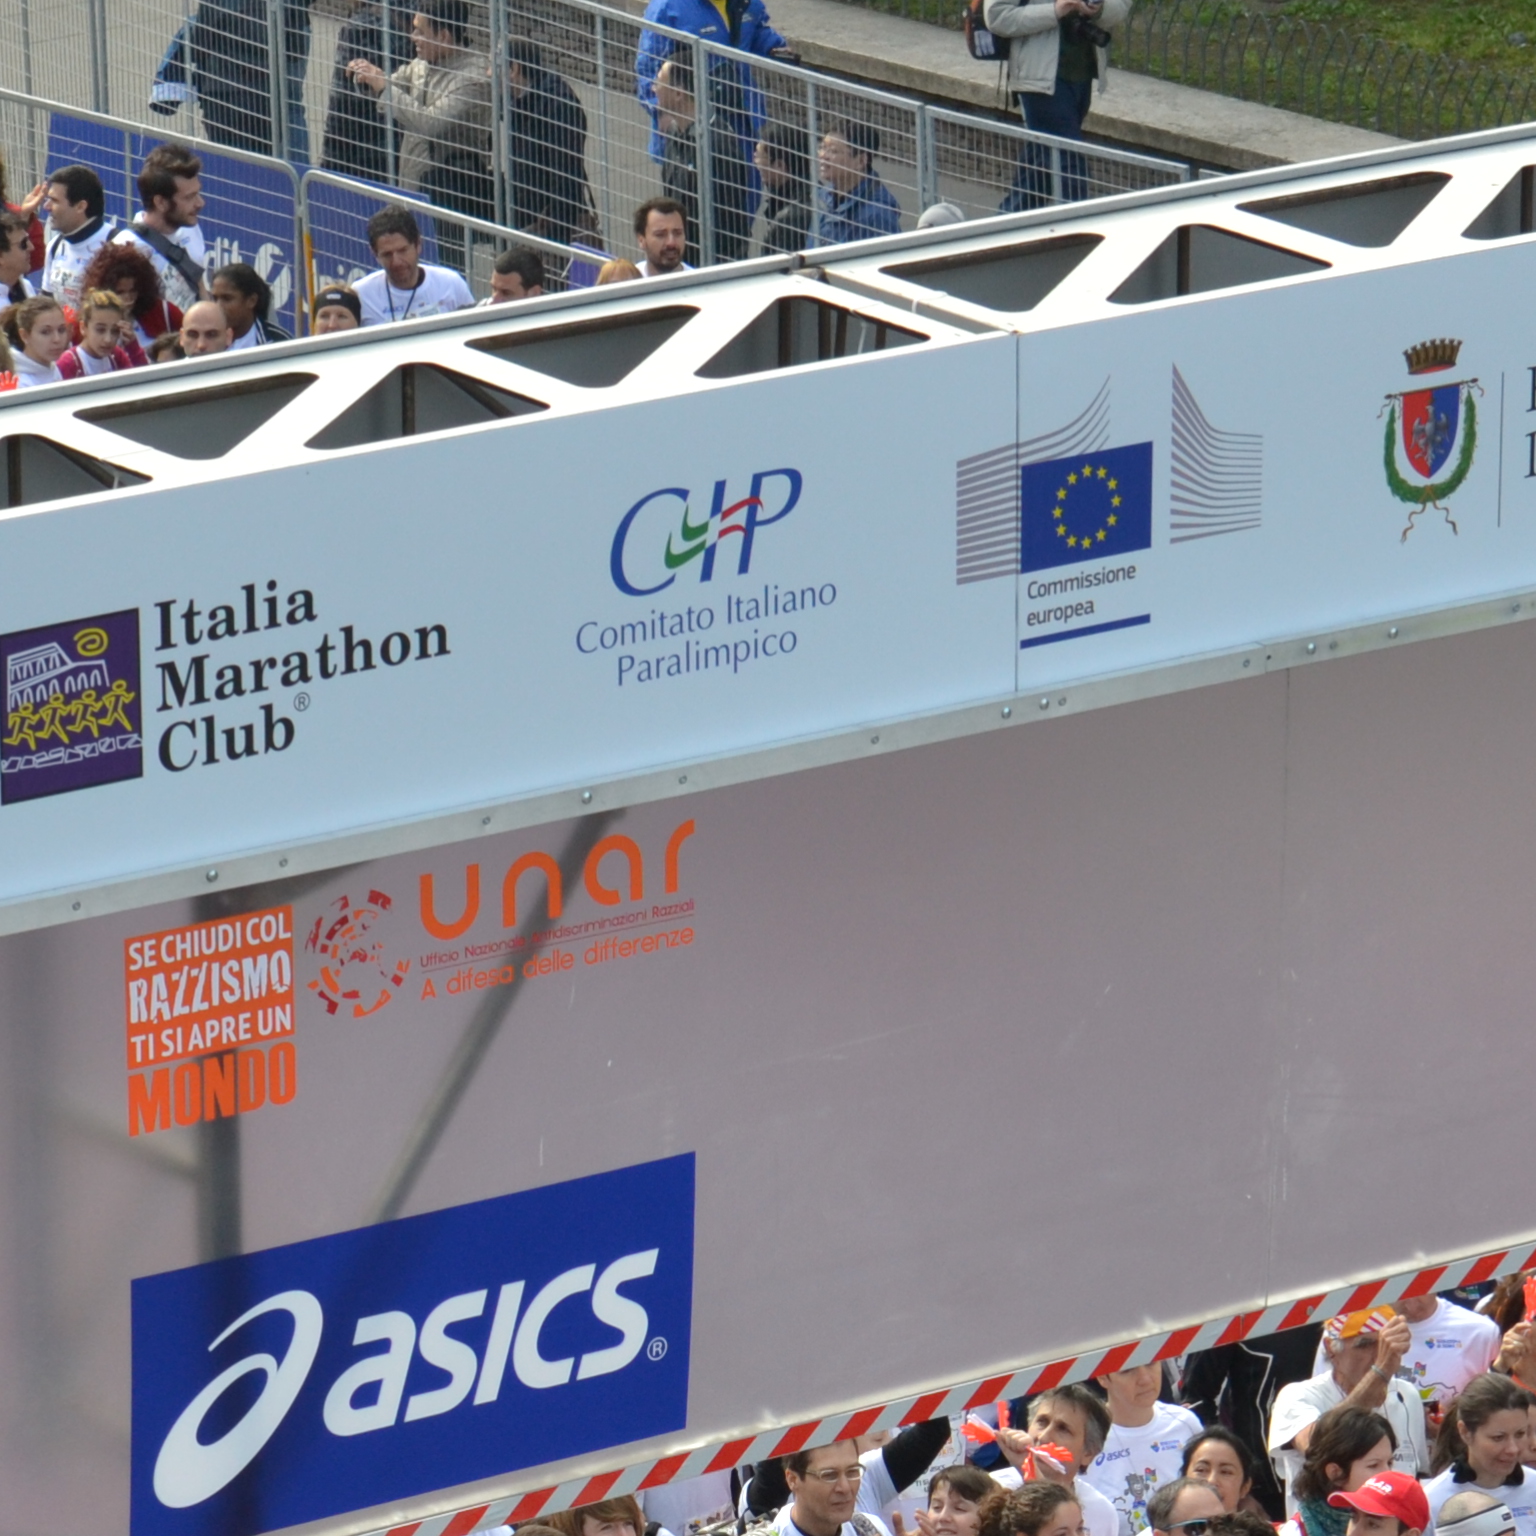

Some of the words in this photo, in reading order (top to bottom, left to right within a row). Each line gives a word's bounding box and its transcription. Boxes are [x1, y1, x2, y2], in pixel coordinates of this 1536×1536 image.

[154, 579, 318, 651] Italia
[575, 604, 716, 656] Comitato
[726, 577, 838, 626] Italiano
[1026, 562, 1137, 600] Commissione
[1026, 599, 1096, 627] europea
[155, 614, 452, 712] Marathon
[616, 628, 799, 688] Paralimpico
[419, 818, 695, 941] unar
[128, 938, 156, 971] SE
[160, 921, 243, 965] CHIUDI
[245, 914, 292, 946] COL
[420, 952, 459, 969] Ufficio
[464, 937, 526, 960] Nazionale
[531, 912, 649, 947] Antidiscriminazioni
[651, 899, 695, 919] Razziali
[420, 979, 436, 1001] A
[445, 964, 514, 996] difesa
[521, 949, 575, 980] delle
[583, 924, 695, 967] differenze
[128, 948, 292, 1027] RAZZISMO
[130, 1033, 155, 1064] TI
[160, 1028, 184, 1058] SI
[187, 1014, 252, 1053] APRE
[257, 1005, 292, 1036] UN
[127, 1041, 297, 1137] MONDO
[1105, 1447, 1131, 1463] asics
